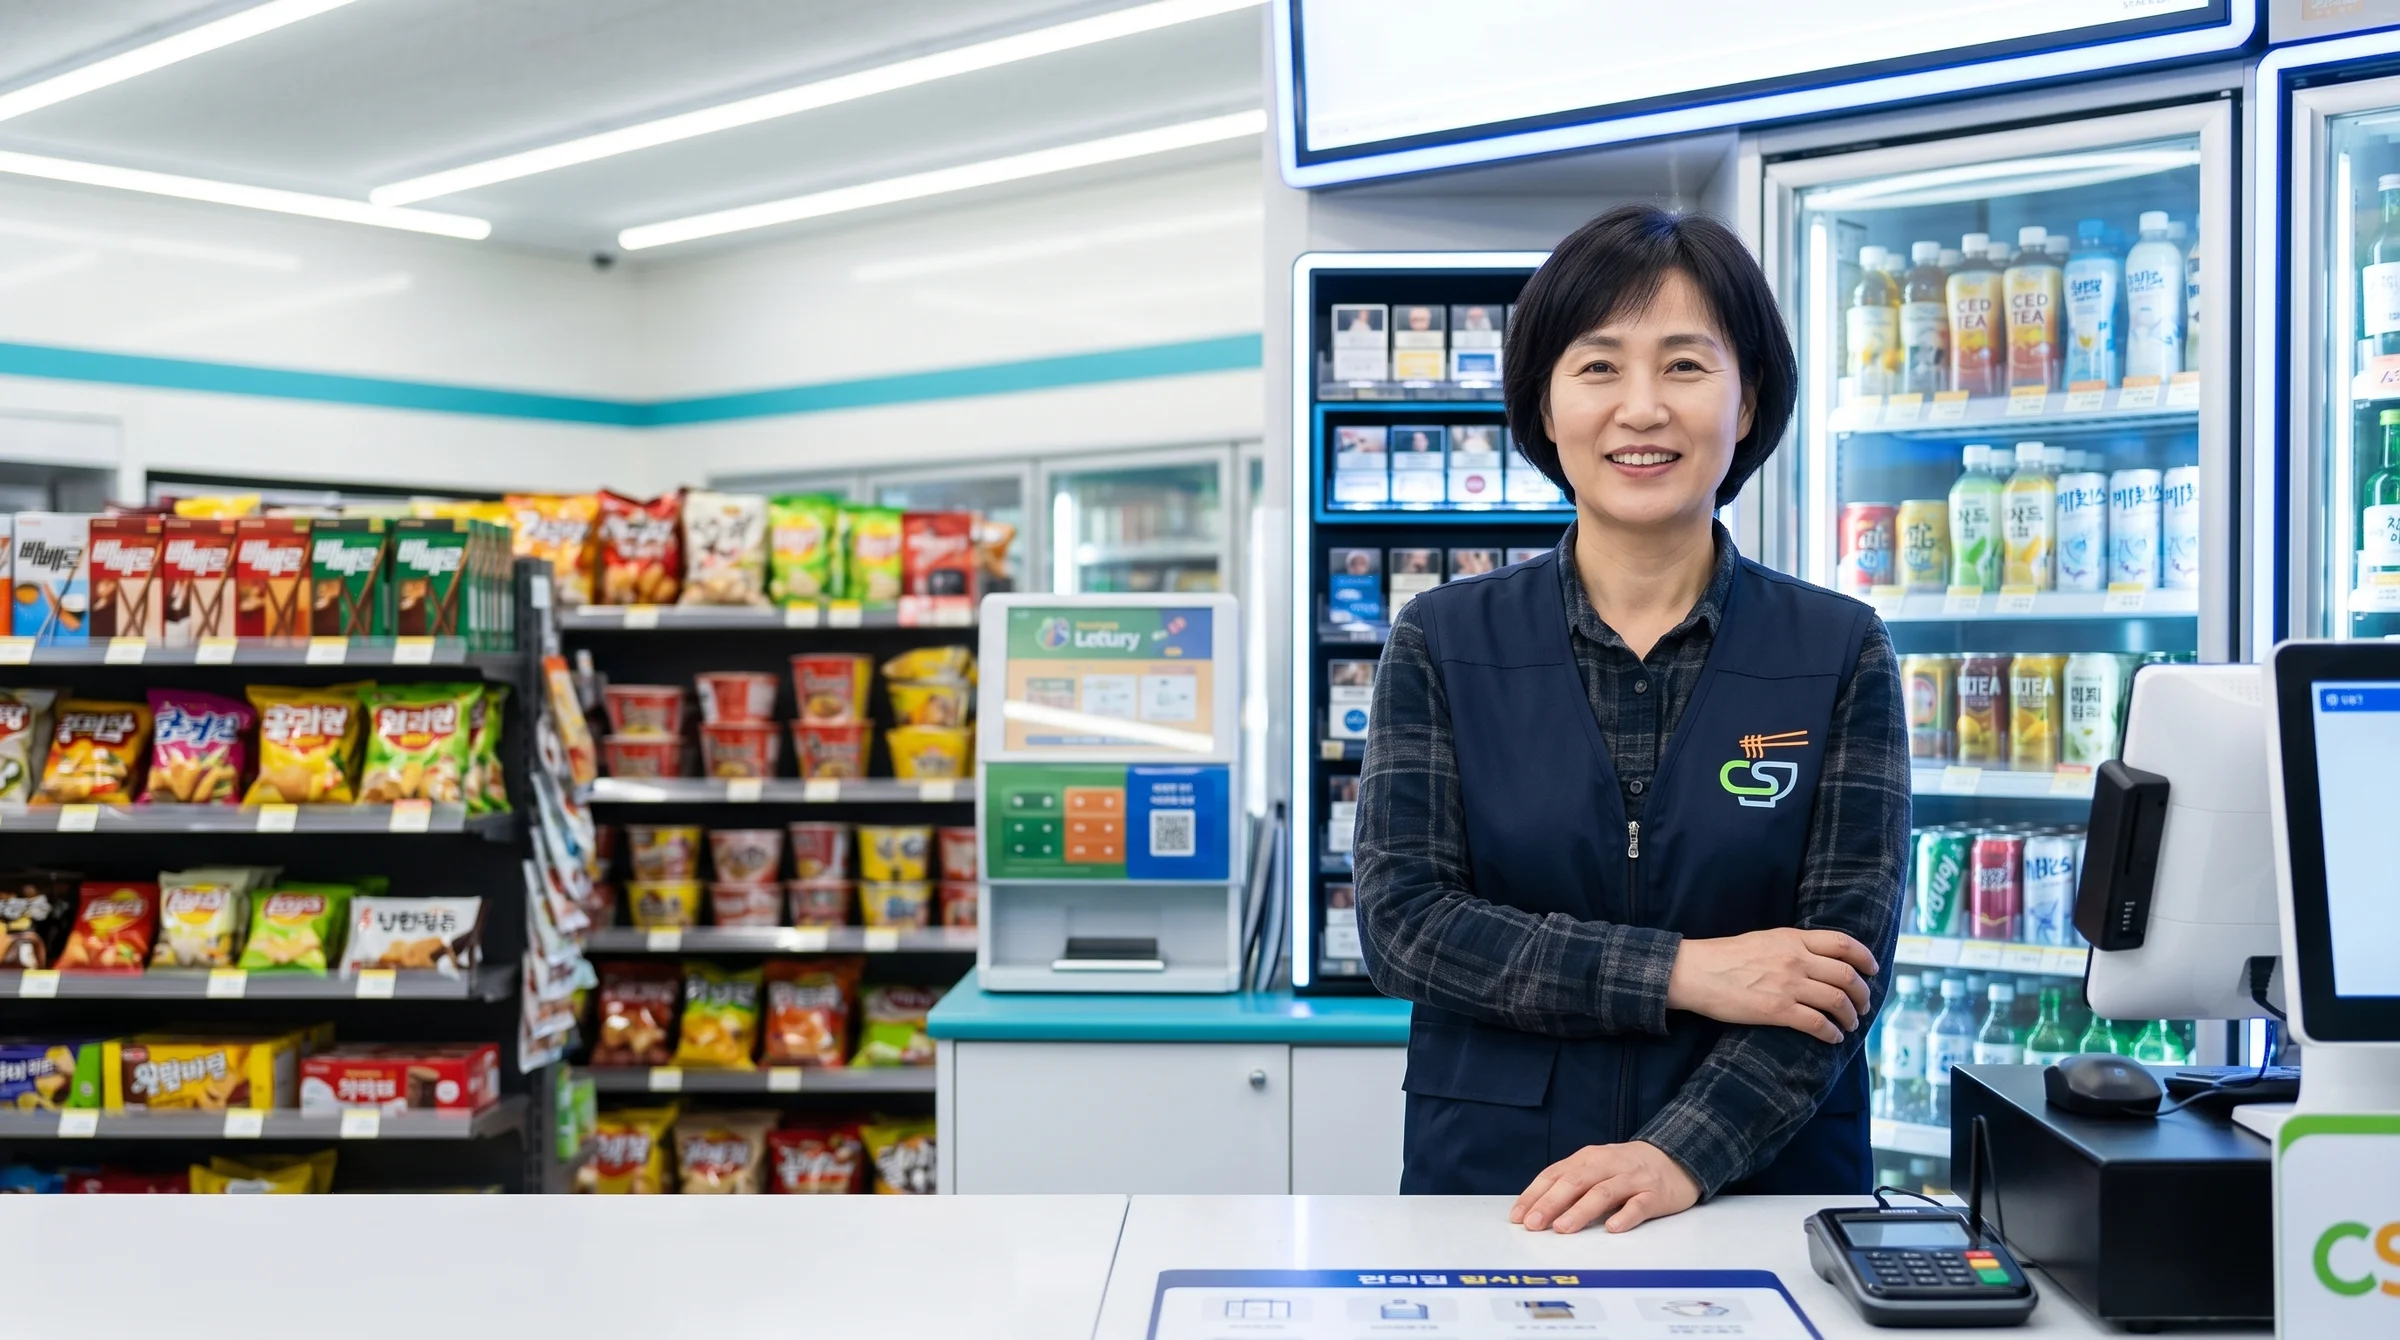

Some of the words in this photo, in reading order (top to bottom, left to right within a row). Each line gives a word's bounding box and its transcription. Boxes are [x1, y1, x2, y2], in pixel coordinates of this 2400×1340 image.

[19, 540, 82, 572] 빼빼로
[91, 540, 154, 576] 빼빼로
[165, 540, 229, 576] 빼빼로
[1720, 759, 1798, 797] CS
